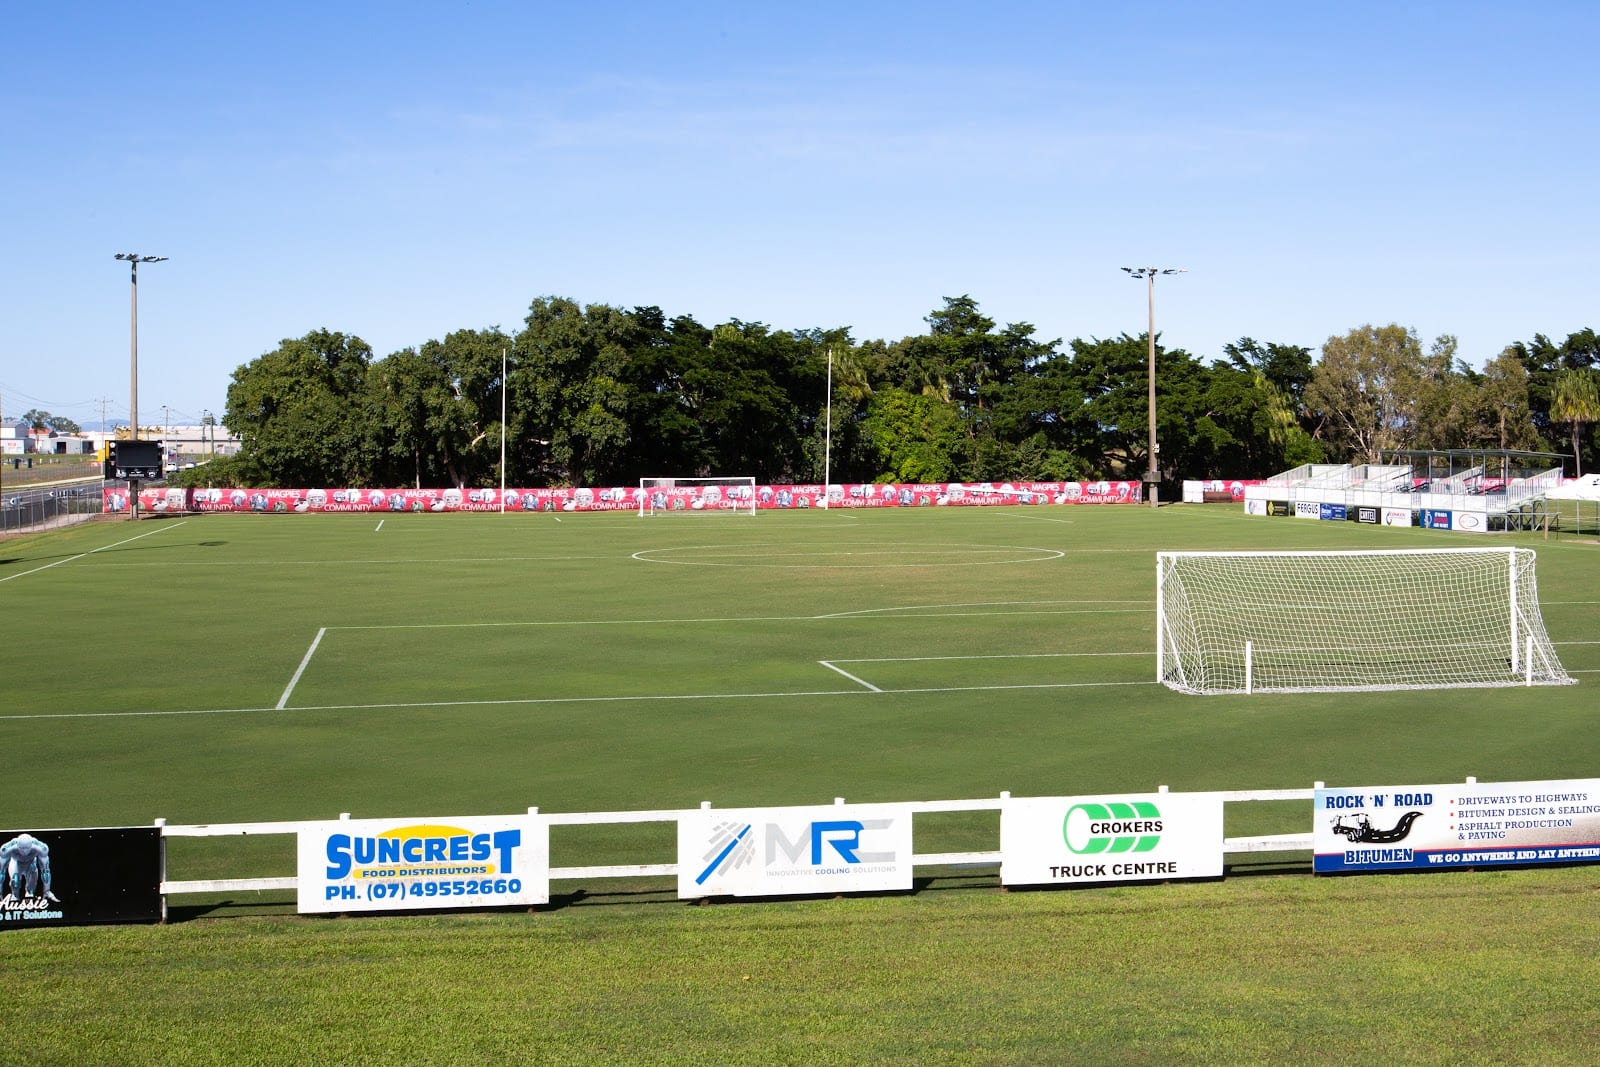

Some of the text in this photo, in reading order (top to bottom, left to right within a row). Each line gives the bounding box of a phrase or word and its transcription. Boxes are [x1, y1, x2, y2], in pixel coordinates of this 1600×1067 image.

[268, 490, 301, 498] MAGPIES
[405, 490, 437, 498] MAGPIES
[791, 486, 822, 494] MAGPIES
[719, 500, 760, 508] COMMUNIY
[962, 497, 1003, 505] COMMUNITY
[1079, 495, 1119, 503] COMMUNITY
[324, 503, 371, 511] COMMUNITY
[1326, 795, 1365, 808] ROCK
[1394, 793, 1433, 806] ROAD
[1458, 796, 1517, 805] DRIVEWAYS
[1535, 793, 1588, 802] HIGHWAYS
[1458, 809, 1505, 818] BITUMEN
[1508, 807, 1546, 816] DESIGN
[1558, 805, 1600, 814] SEALING
[1090, 821, 1163, 834] CROKERS
[1458, 819, 1572, 830] ASPHALT PRODUCTION
[1468, 831, 1506, 839] PAVING
[765, 818, 896, 866] MRC
[326, 829, 520, 880] SUNCREST
[1345, 848, 1413, 864] BITUMEN
[1428, 848, 1600, 863] WE GO ANYWHERE AND LAY ANYTHIN
[362, 866, 487, 878] FOOD DISTRIBUTORS
[766, 866, 897, 878] INNOVATIVE COOLING SOLUTIONS
[1050, 862, 1177, 877] TRUCK CENTRE
[326, 885, 361, 900] PH.
[0, 893, 49, 911] Aussie
[13, 911, 22, 920] IT
[23, 910, 63, 919] Solutions
